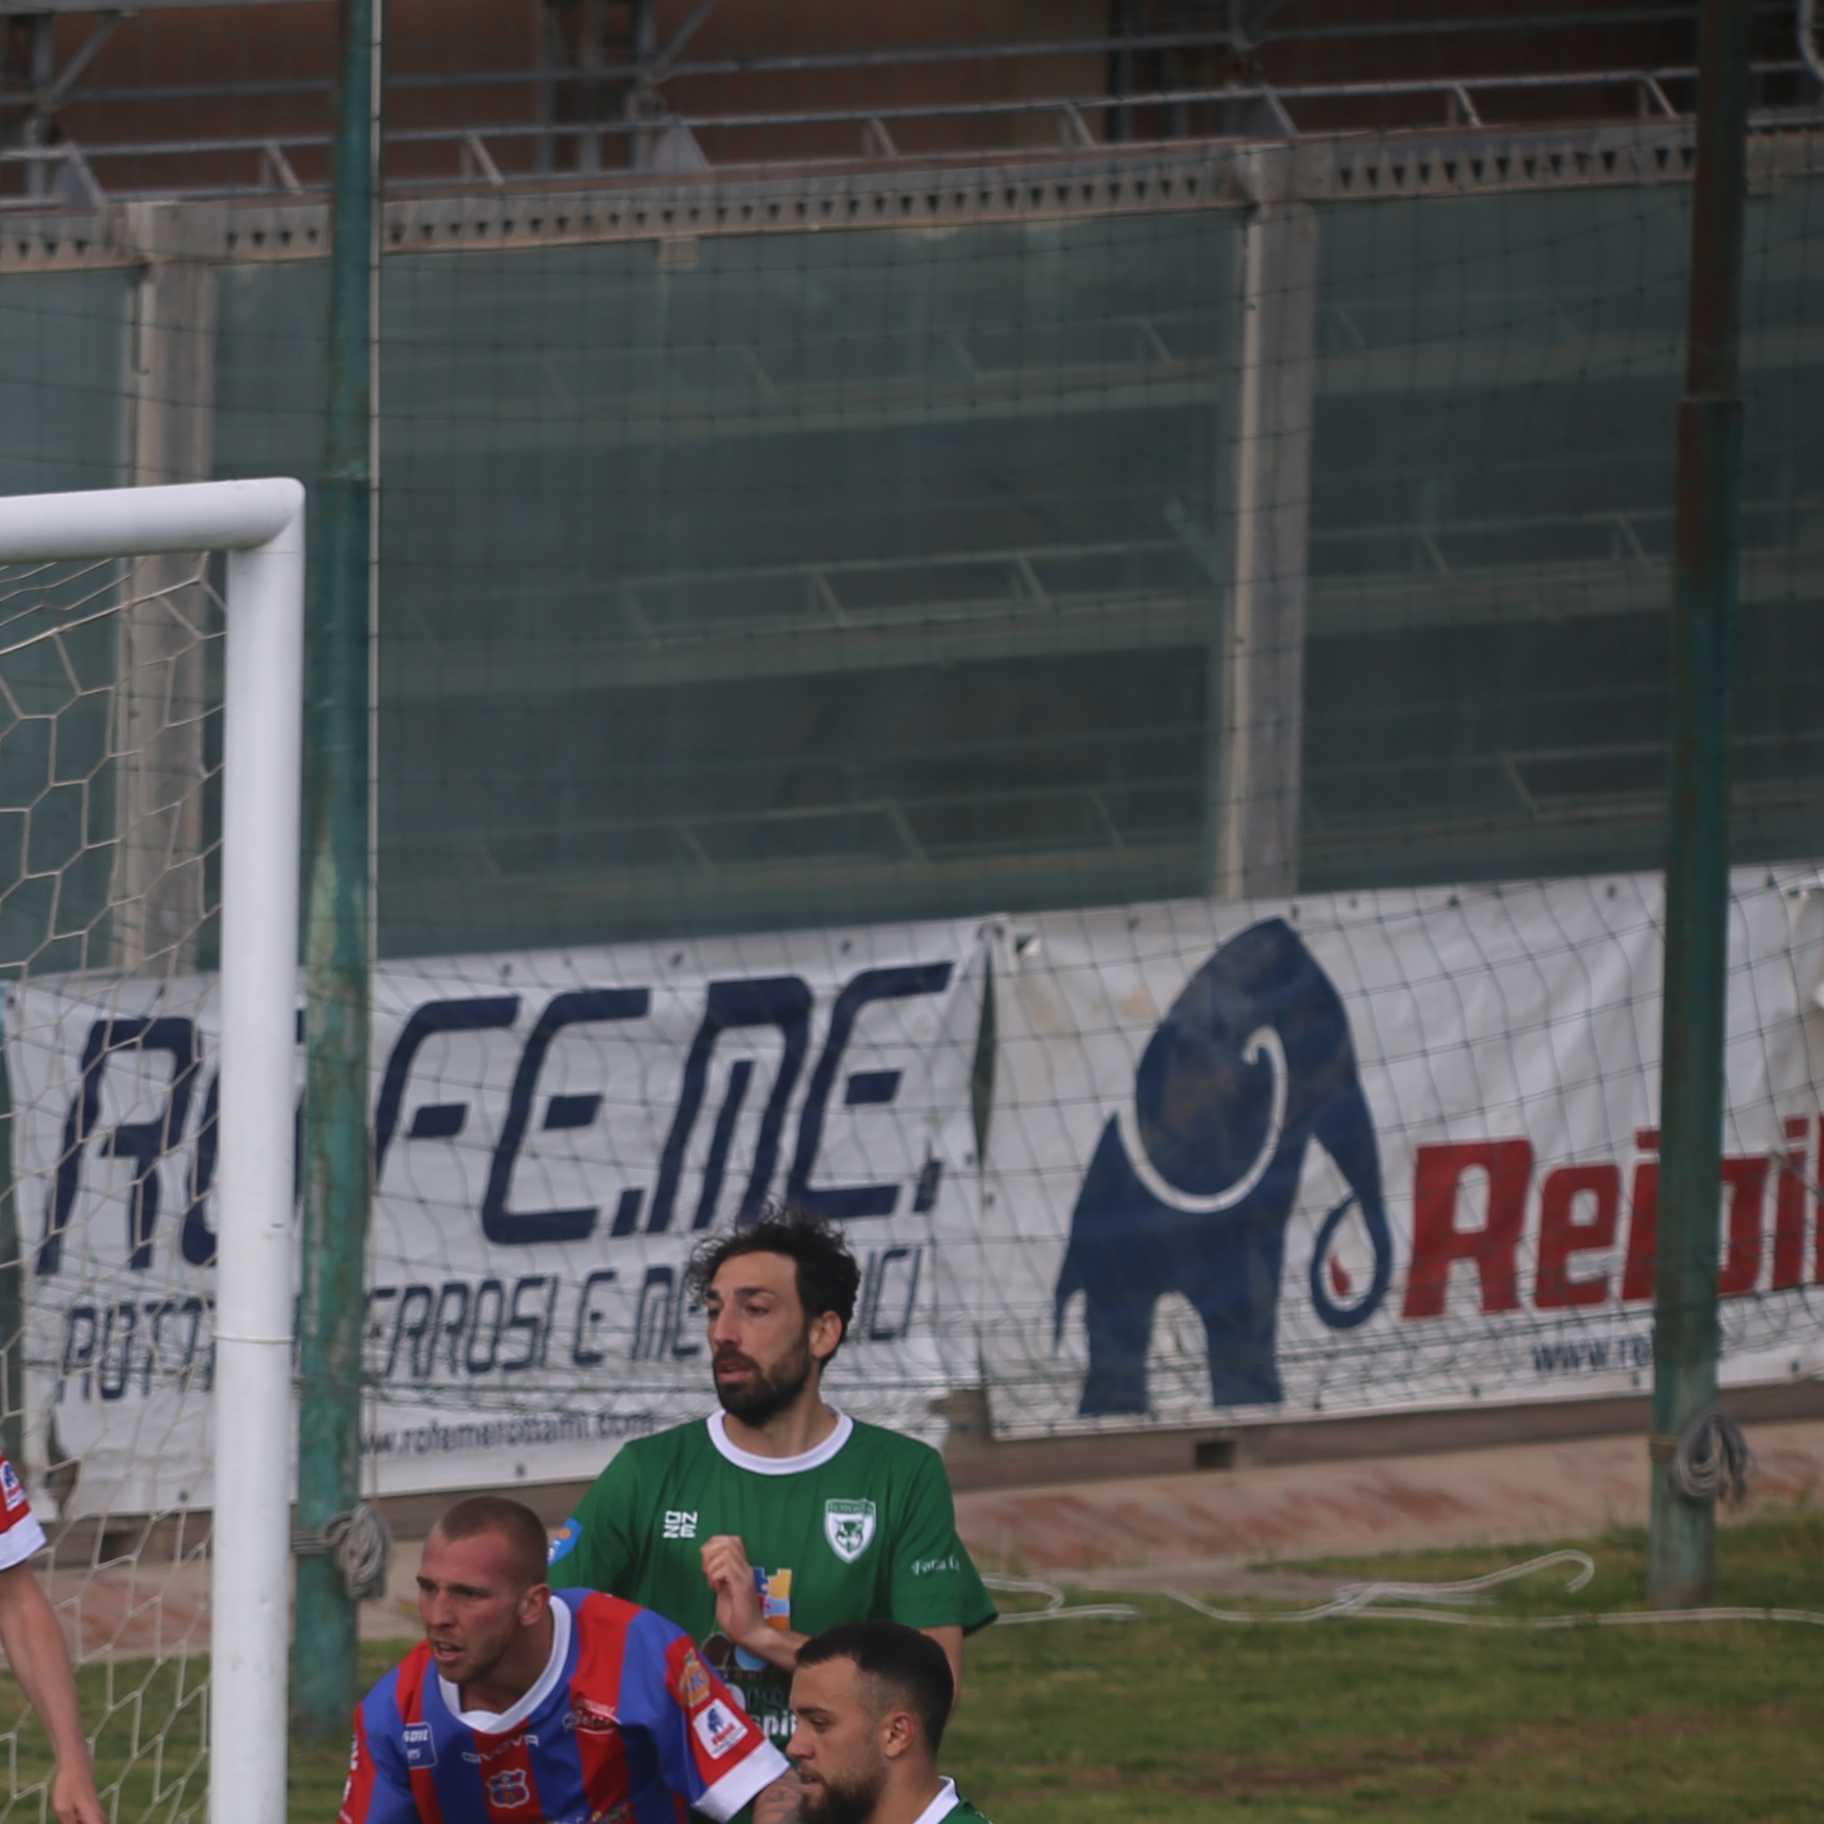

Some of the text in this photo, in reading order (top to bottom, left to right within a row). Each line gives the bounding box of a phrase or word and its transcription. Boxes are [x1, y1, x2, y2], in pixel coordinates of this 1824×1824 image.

[35, 961, 951, 1275] RFE.ME.
[1402, 1113, 1823, 1321] Reii
[364, 1276, 558, 1379] ERROSI
